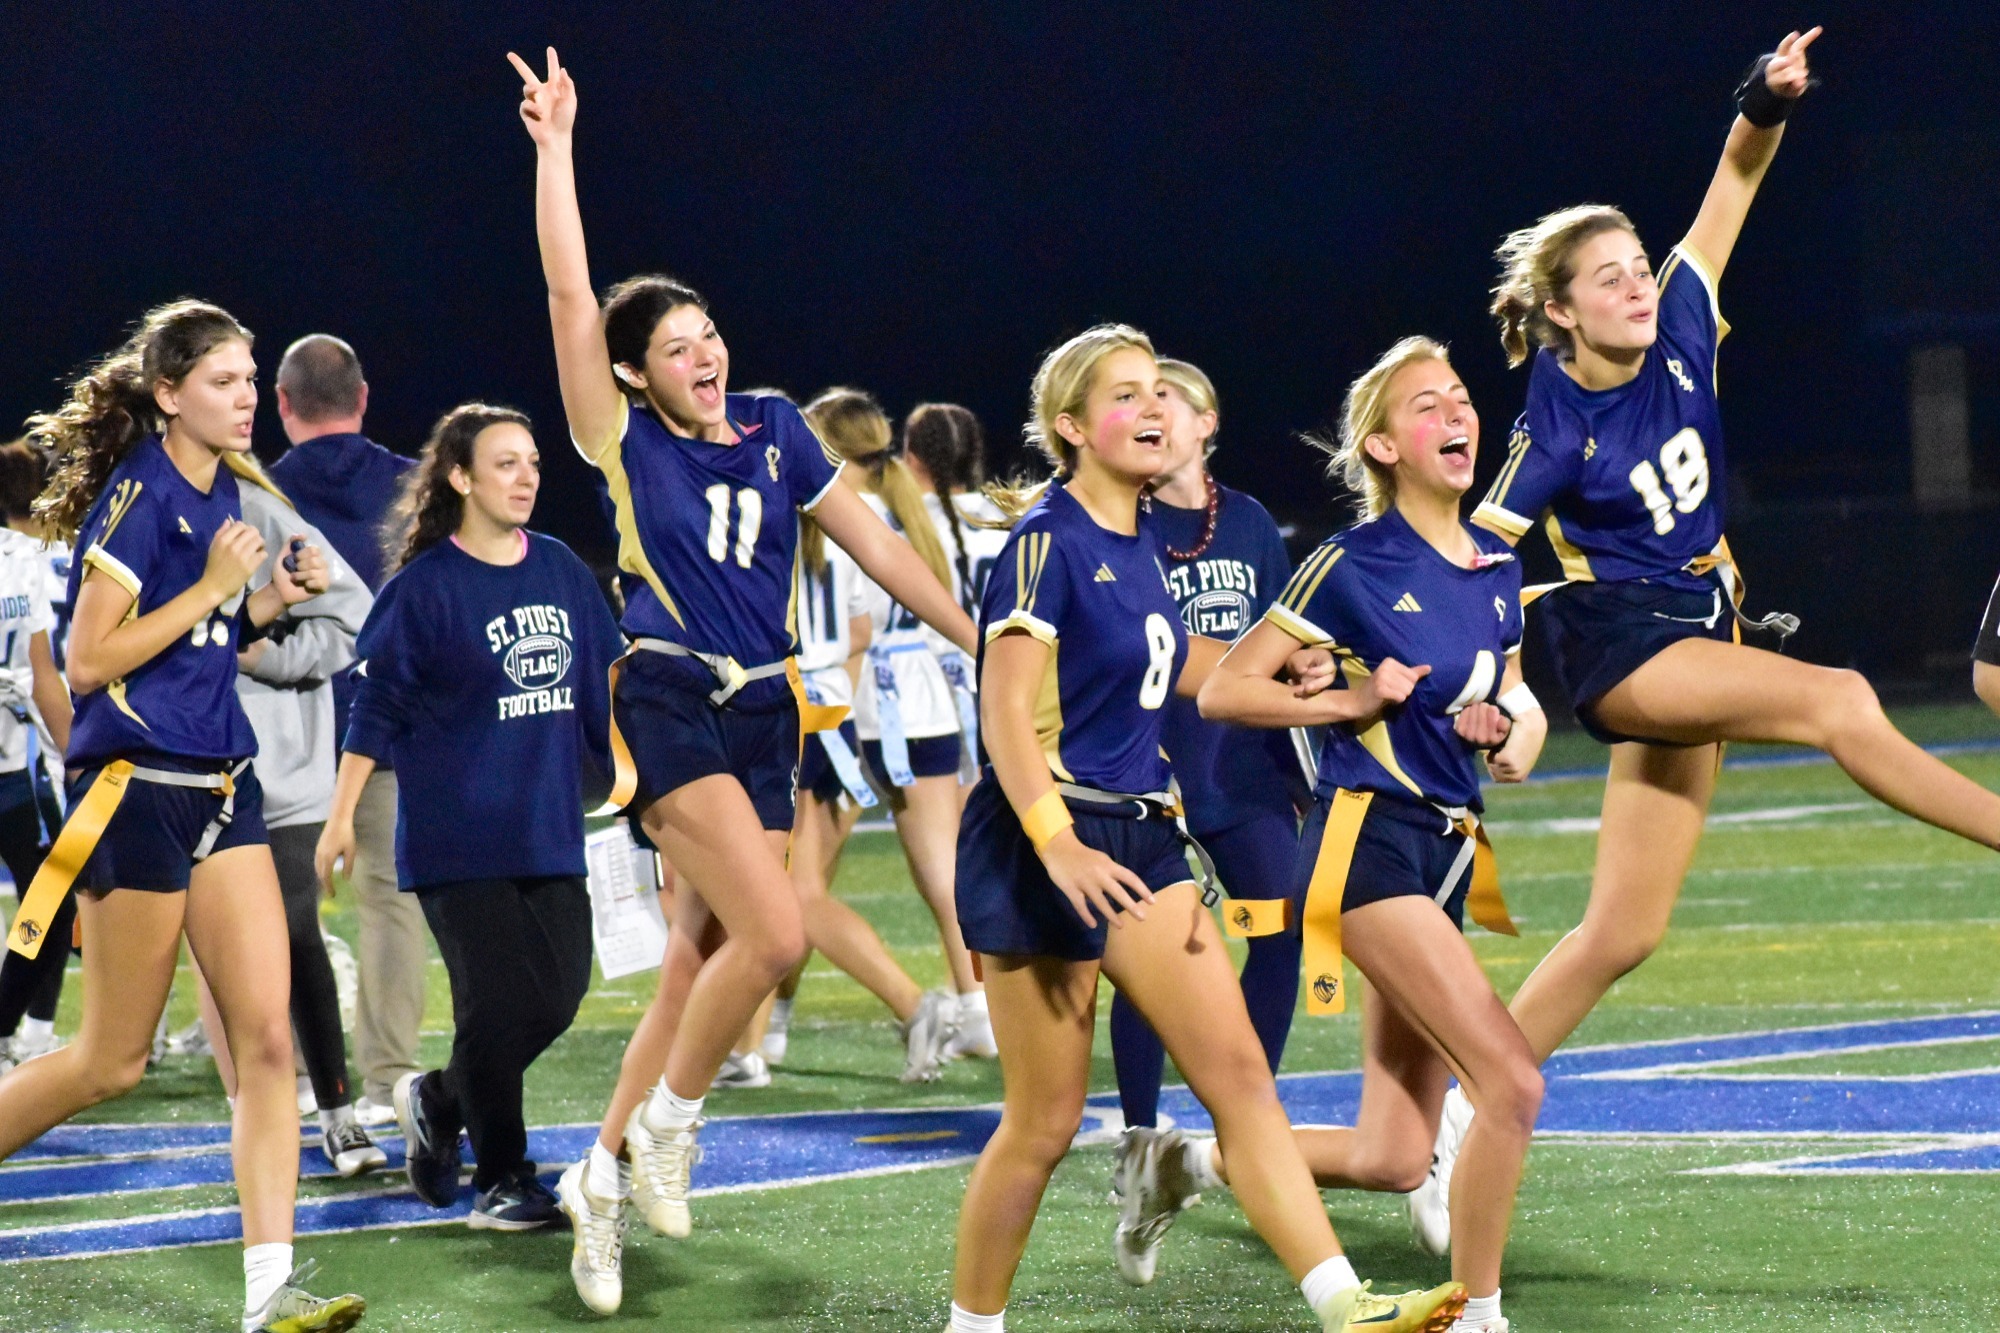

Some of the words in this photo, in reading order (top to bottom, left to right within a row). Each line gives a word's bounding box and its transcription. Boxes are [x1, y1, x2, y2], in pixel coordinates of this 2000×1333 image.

[1629, 427, 1709, 536] 18
[706, 484, 762, 569] 11
[1169, 565, 1196, 601] ST.
[1196, 559, 1246, 591] PIUS
[486, 615, 515, 653] ST.
[512, 605, 560, 637] PIUS
[1200, 611, 1239, 632] FLAG
[520, 654, 557, 678] FLAG
[1139, 613, 1176, 710] 8
